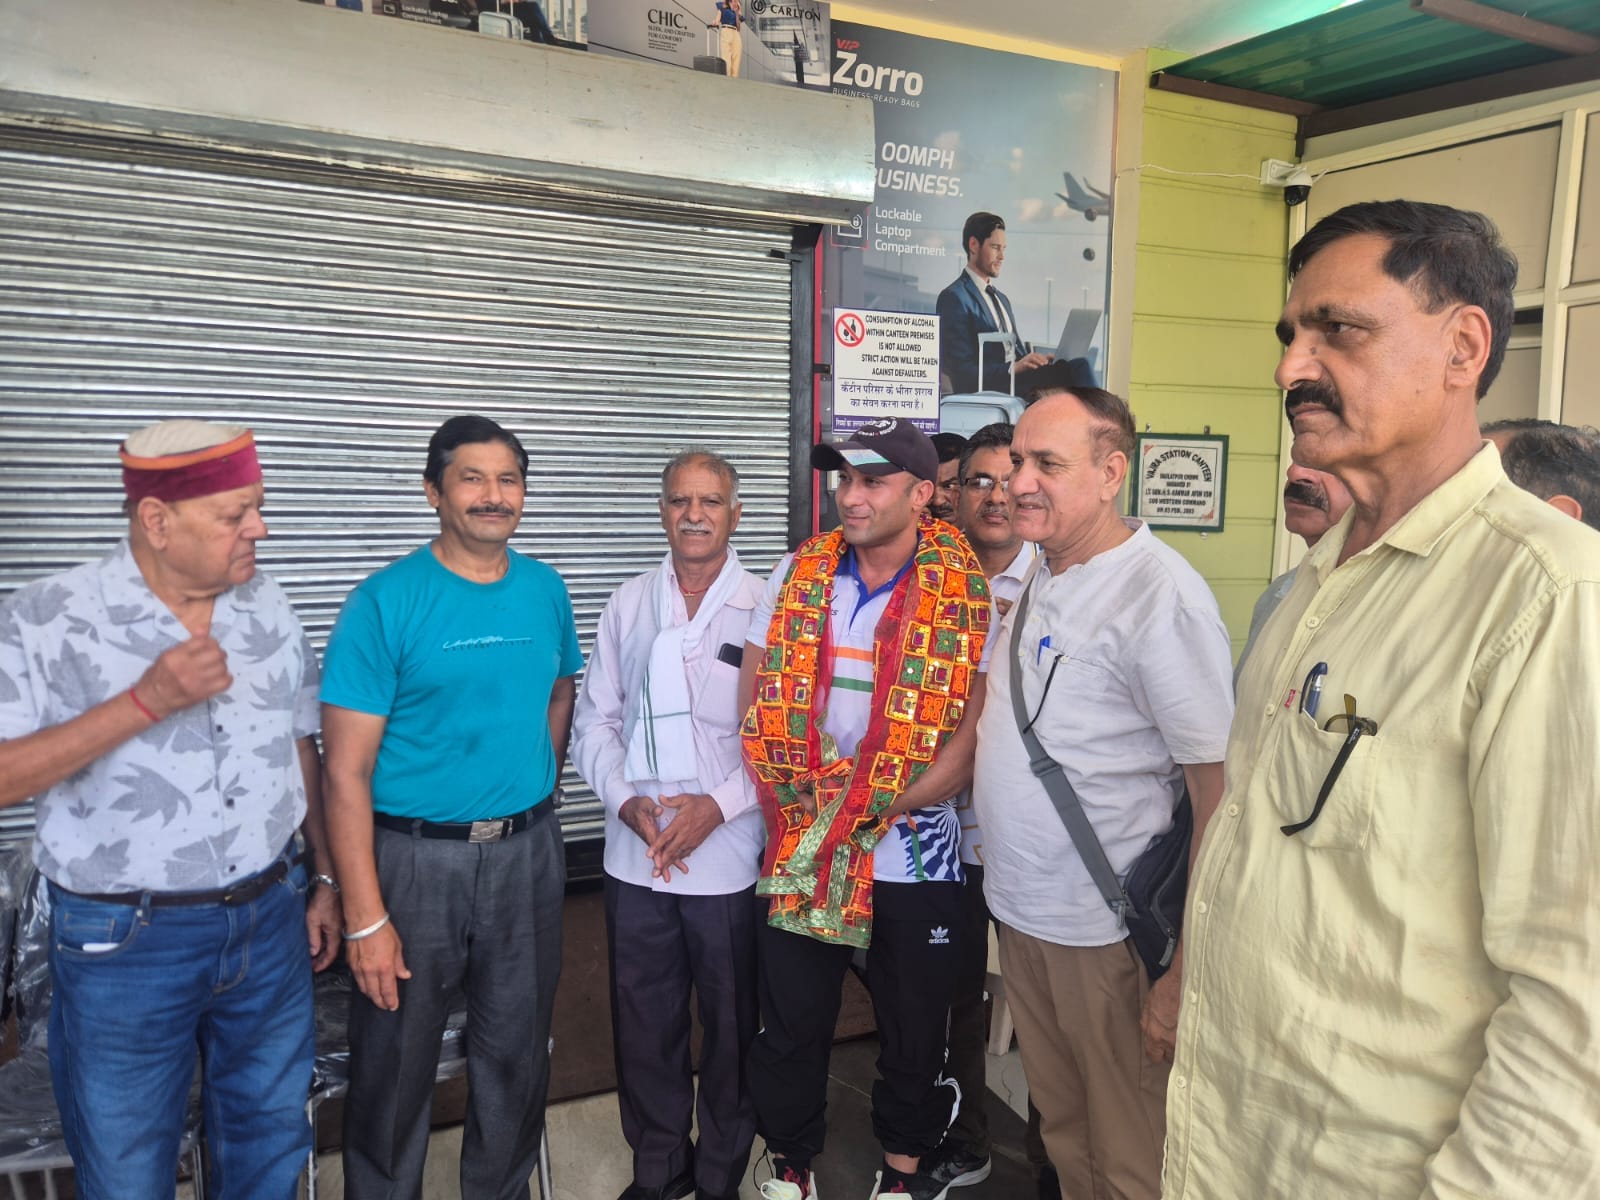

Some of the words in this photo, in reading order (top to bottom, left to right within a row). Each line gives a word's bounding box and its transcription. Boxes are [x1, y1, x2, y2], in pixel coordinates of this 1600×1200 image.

[648, 9, 687, 29] CHIC.
[770, 4, 821, 21] CARLTON
[836, 38, 860, 50] VIP
[832, 50, 923, 96] Zorro
[901, 98, 920, 108] BAGS
[881, 141, 955, 170] OOMPH
[875, 206, 922, 222] Lockable
[875, 222, 912, 240] Laptop
[875, 239, 946, 256] Compartment
[865, 315, 902, 325] CONSUMPTION
[903, 317, 911, 326] OF
[866, 328, 884, 337] WITHIN
[885, 329, 909, 339] CANTEEN
[910, 331, 935, 340] PREMISES
[878, 342, 884, 350] IS
[885, 343, 895, 351] NOT
[896, 344, 922, 352] ALLOWED
[861, 353, 879, 362] STRICT
[880, 355, 899, 364] ACTION
[900, 357, 912, 365] WILL
[913, 357, 921, 365] BE
[921, 357, 938, 366] TAKEN
[872, 367, 894, 376] AGAINST
[1160, 449, 1192, 462] STATION
[1191, 453, 1212, 482] CANTEEN
